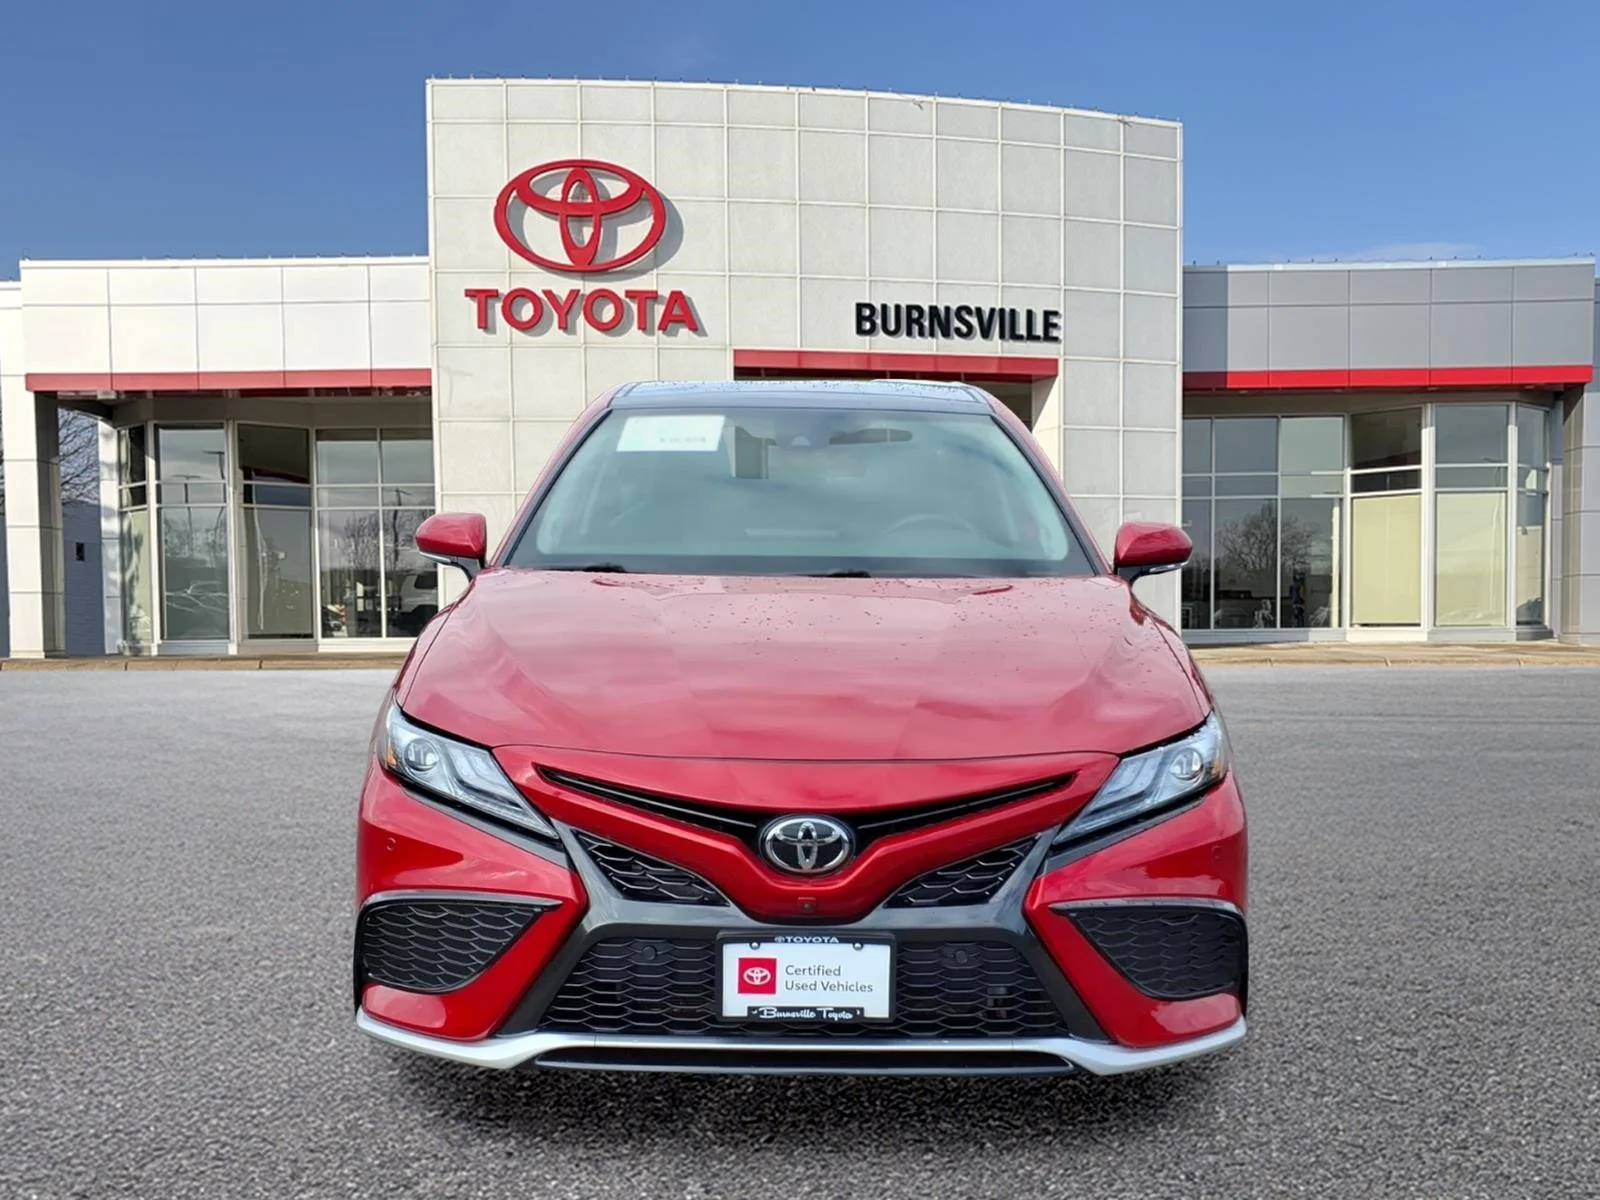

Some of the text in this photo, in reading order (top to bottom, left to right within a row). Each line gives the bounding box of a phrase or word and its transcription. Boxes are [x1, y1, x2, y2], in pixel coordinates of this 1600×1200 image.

[464, 287, 698, 332] TOYOTA
[855, 302, 1061, 342] BURNSVILLE
[785, 935, 840, 944] TOYOTA
[785, 964, 842, 977] Certified
[785, 980, 873, 993] Used Vehicles
[758, 1006, 853, 1021] Burnsville Toyota
